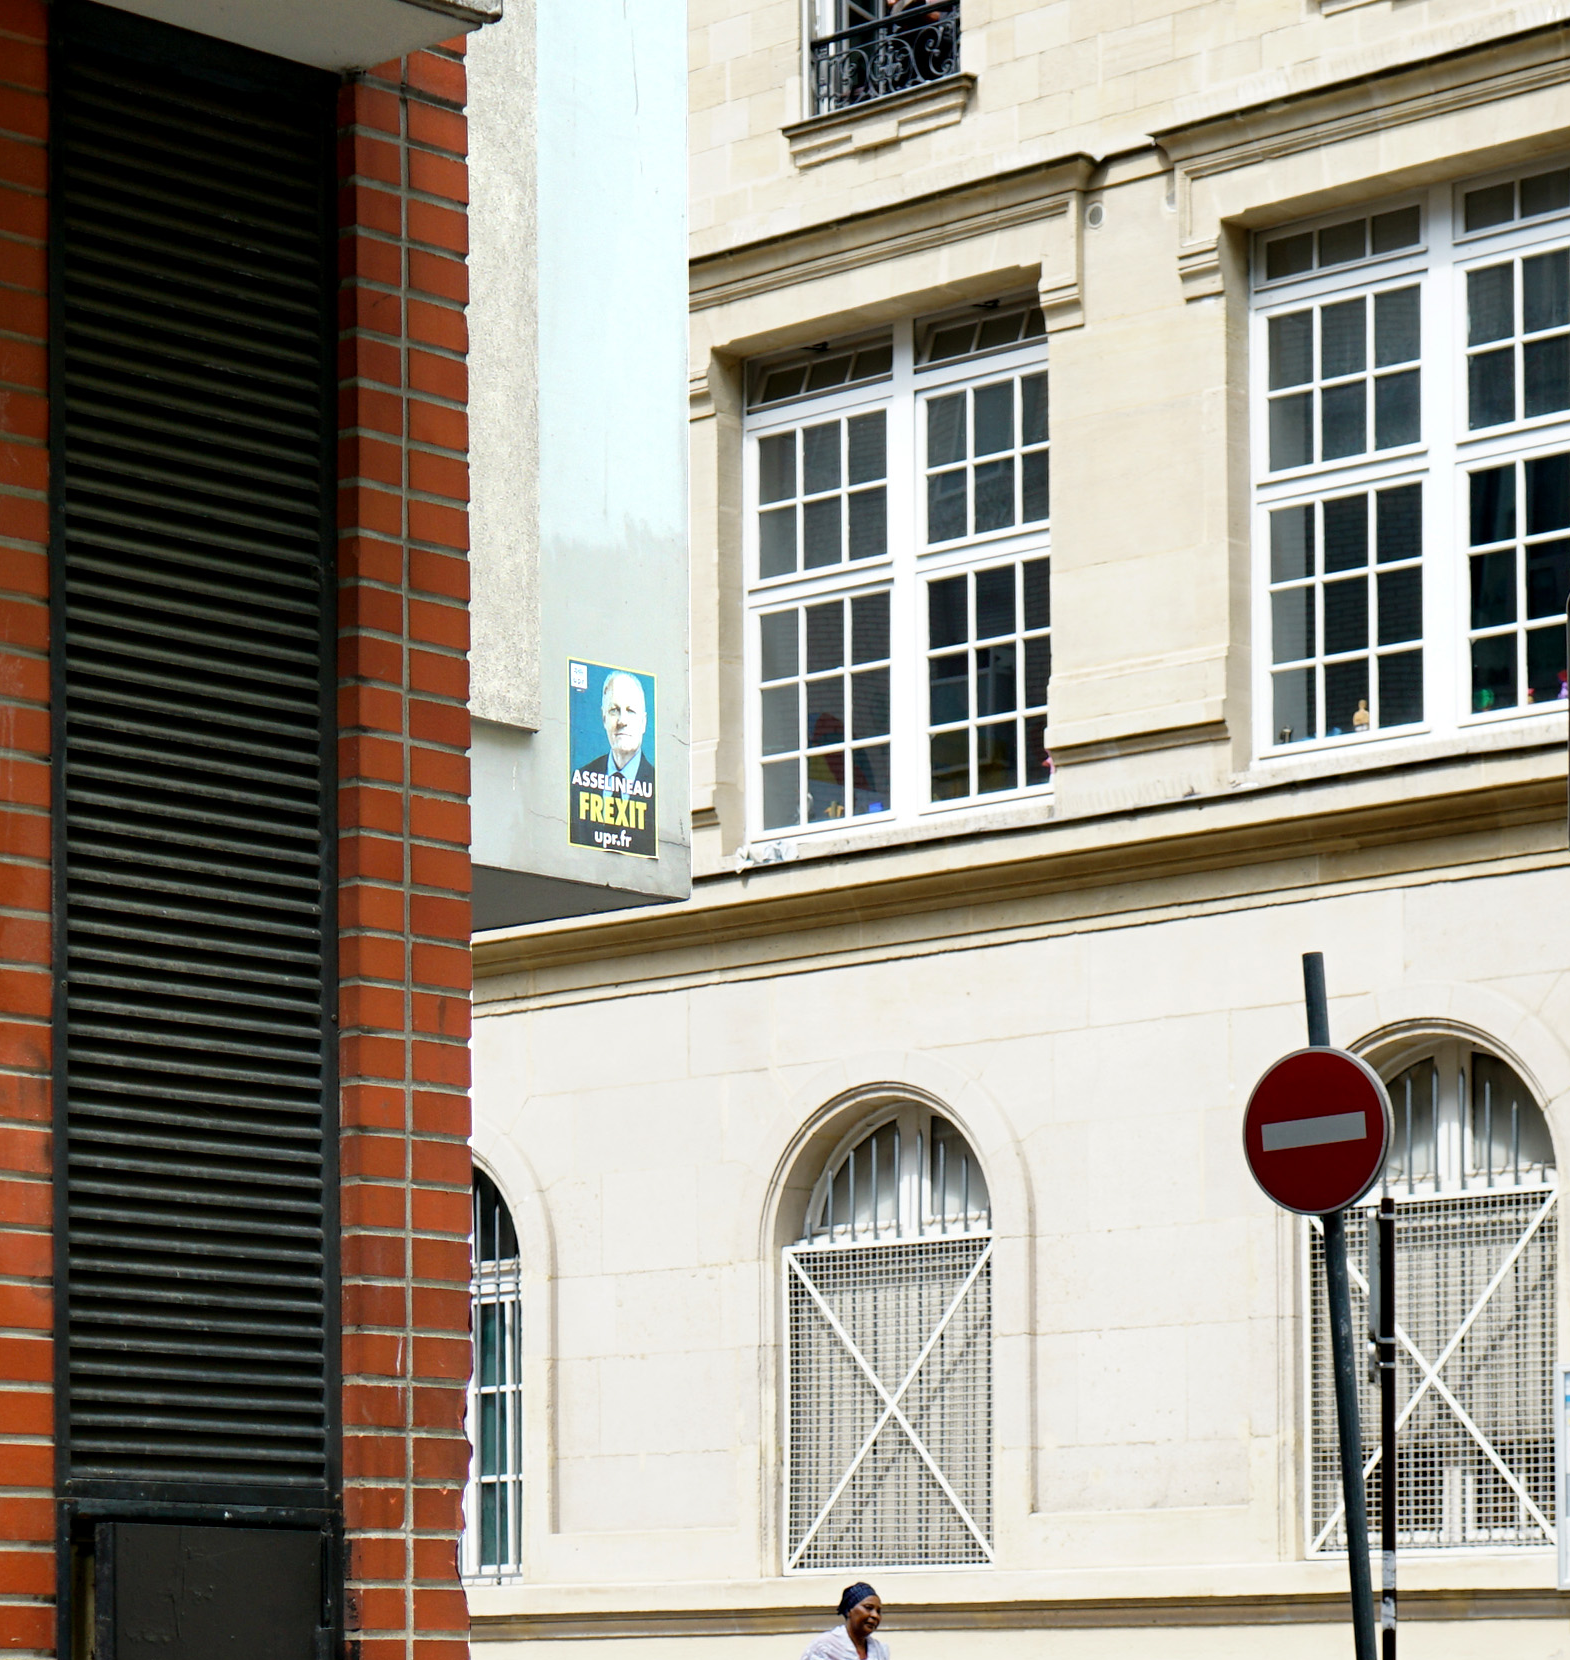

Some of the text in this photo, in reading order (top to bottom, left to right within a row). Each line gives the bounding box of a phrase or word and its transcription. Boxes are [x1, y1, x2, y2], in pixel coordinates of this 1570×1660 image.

[571, 769, 653, 798] ASSELINEAU
[579, 791, 648, 830] FREXIT
[594, 829, 632, 849] upr.fr
